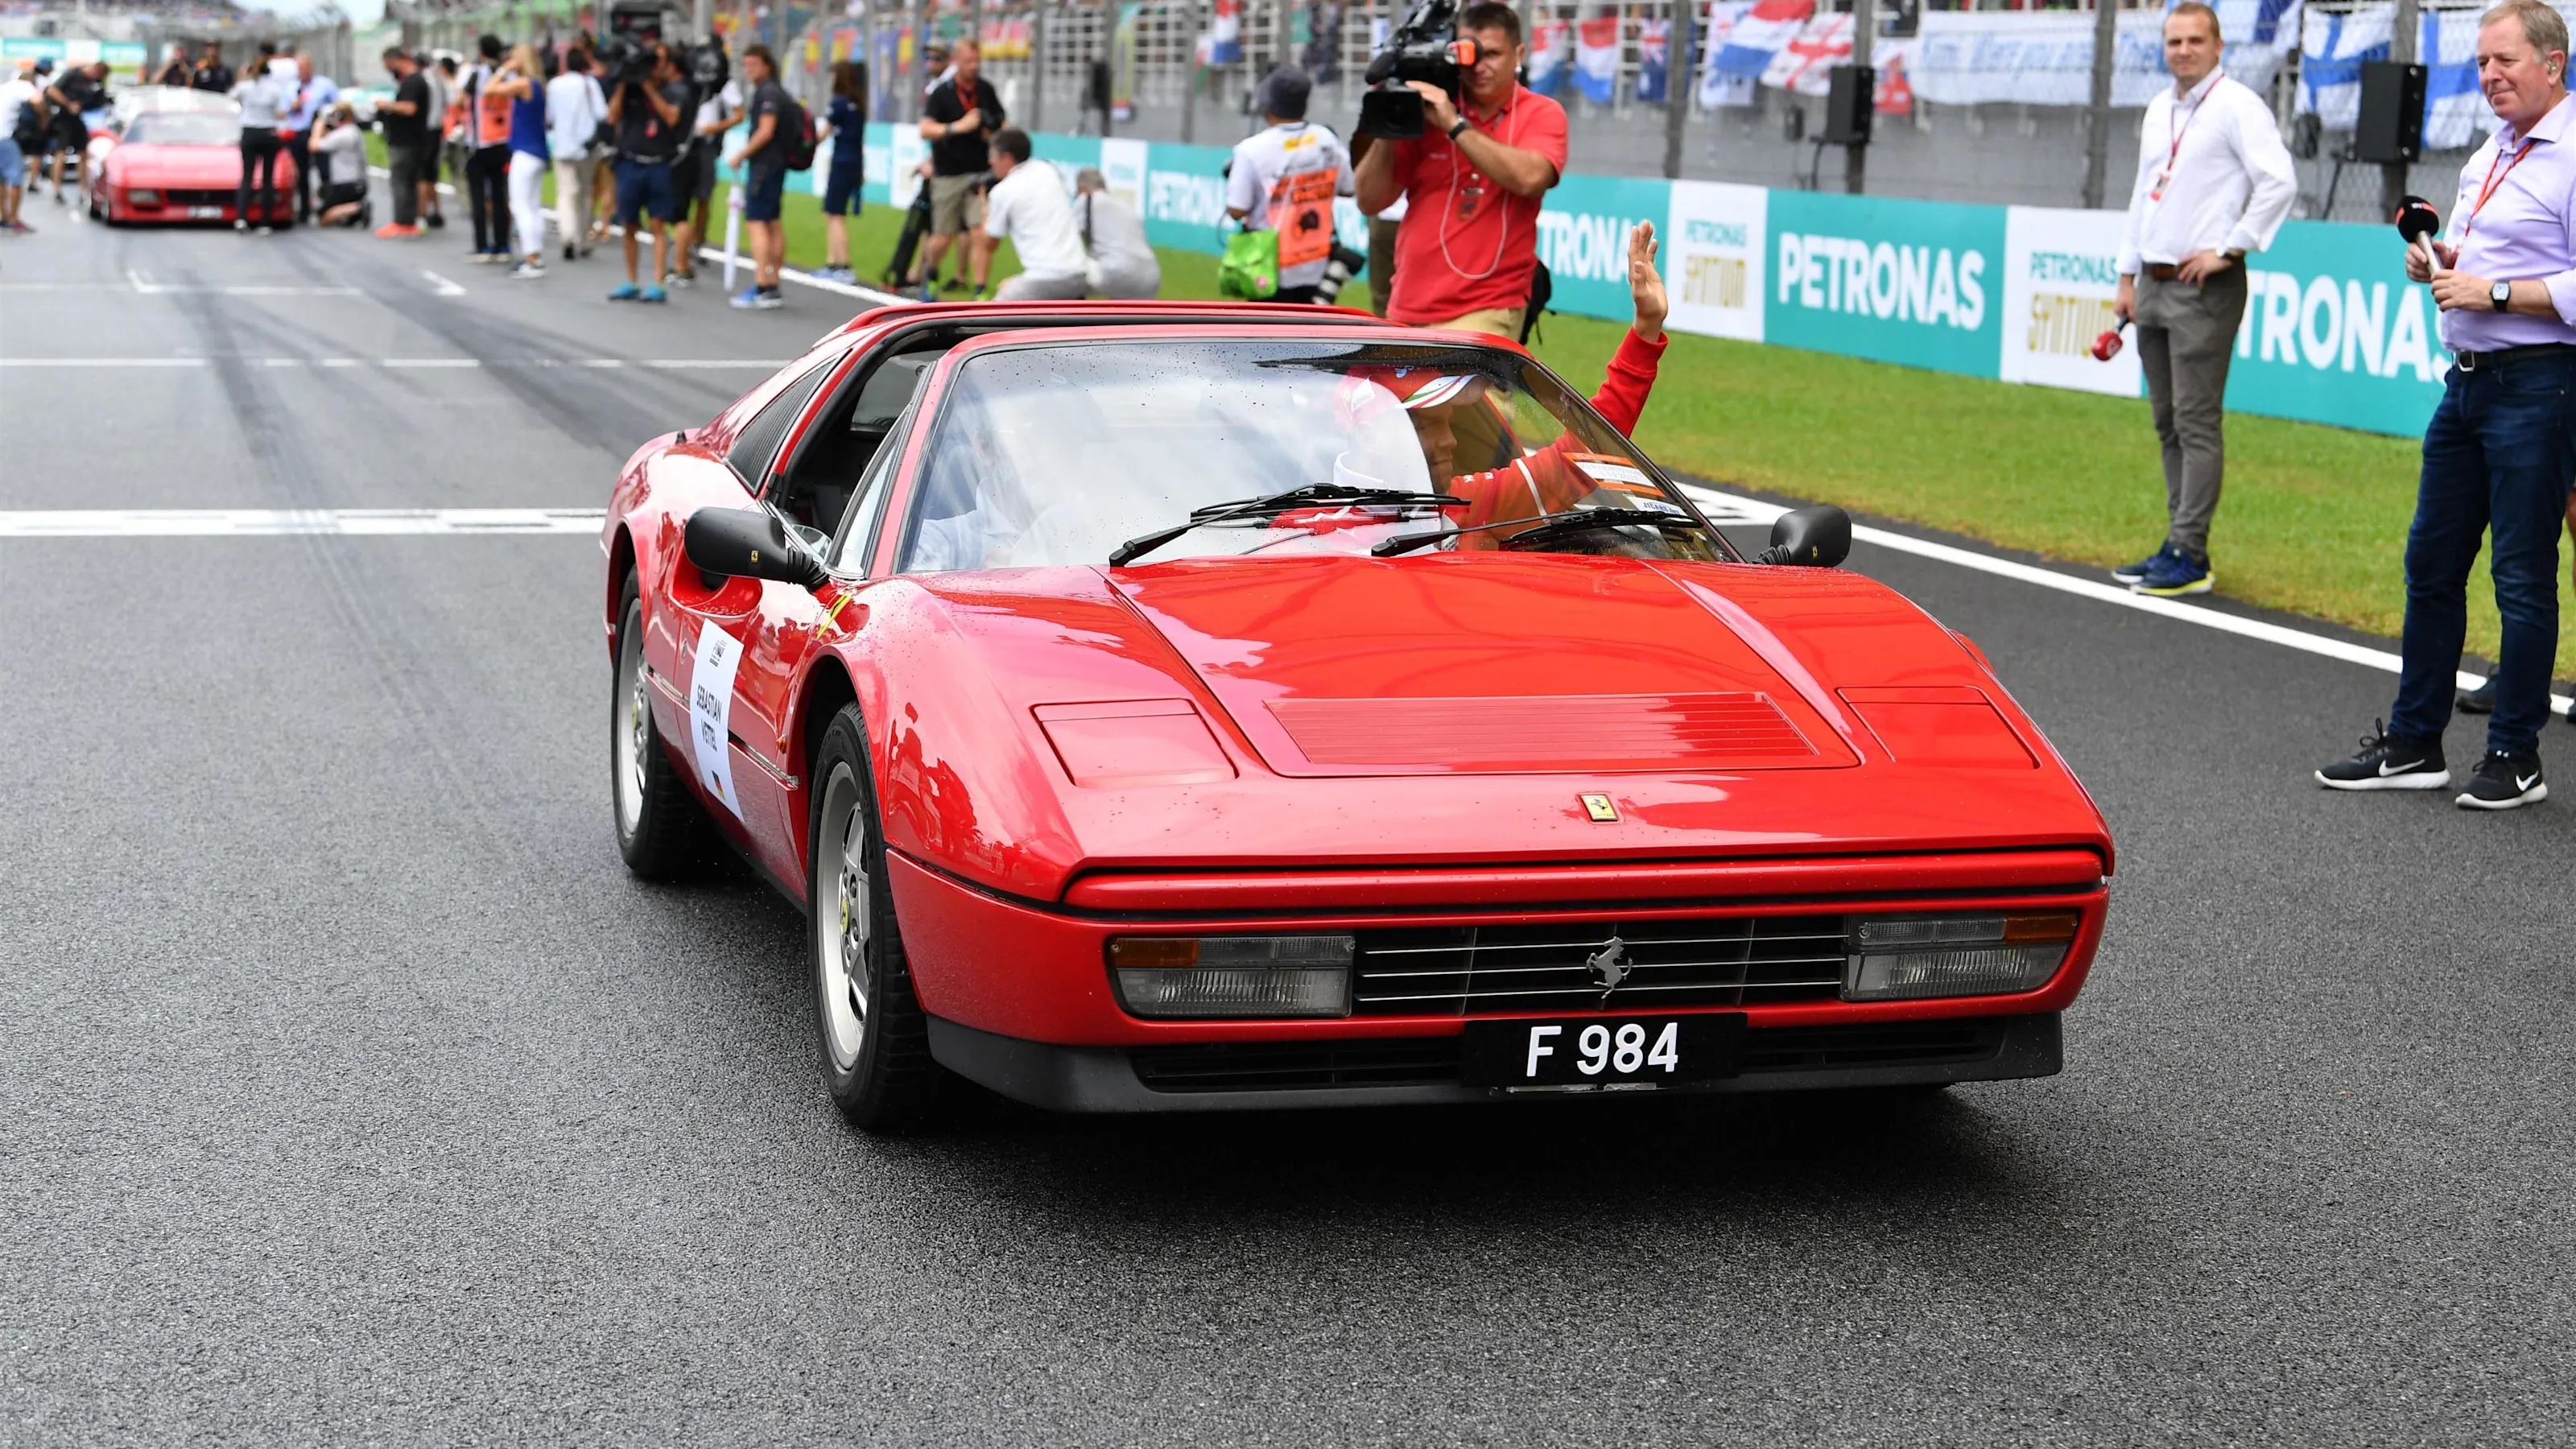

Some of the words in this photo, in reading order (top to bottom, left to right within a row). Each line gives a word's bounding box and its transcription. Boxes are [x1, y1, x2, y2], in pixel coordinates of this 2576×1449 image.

[1686, 220, 1747, 246] PETRONAS
[1777, 231, 1985, 332] PETRONAS
[2238, 269, 2450, 386] TRONA
[696, 684, 723, 722] SEBASTIAN
[701, 720, 718, 752] VETTEL
[1526, 1026, 1563, 1077] F
[1576, 1022, 1678, 1075] 984
